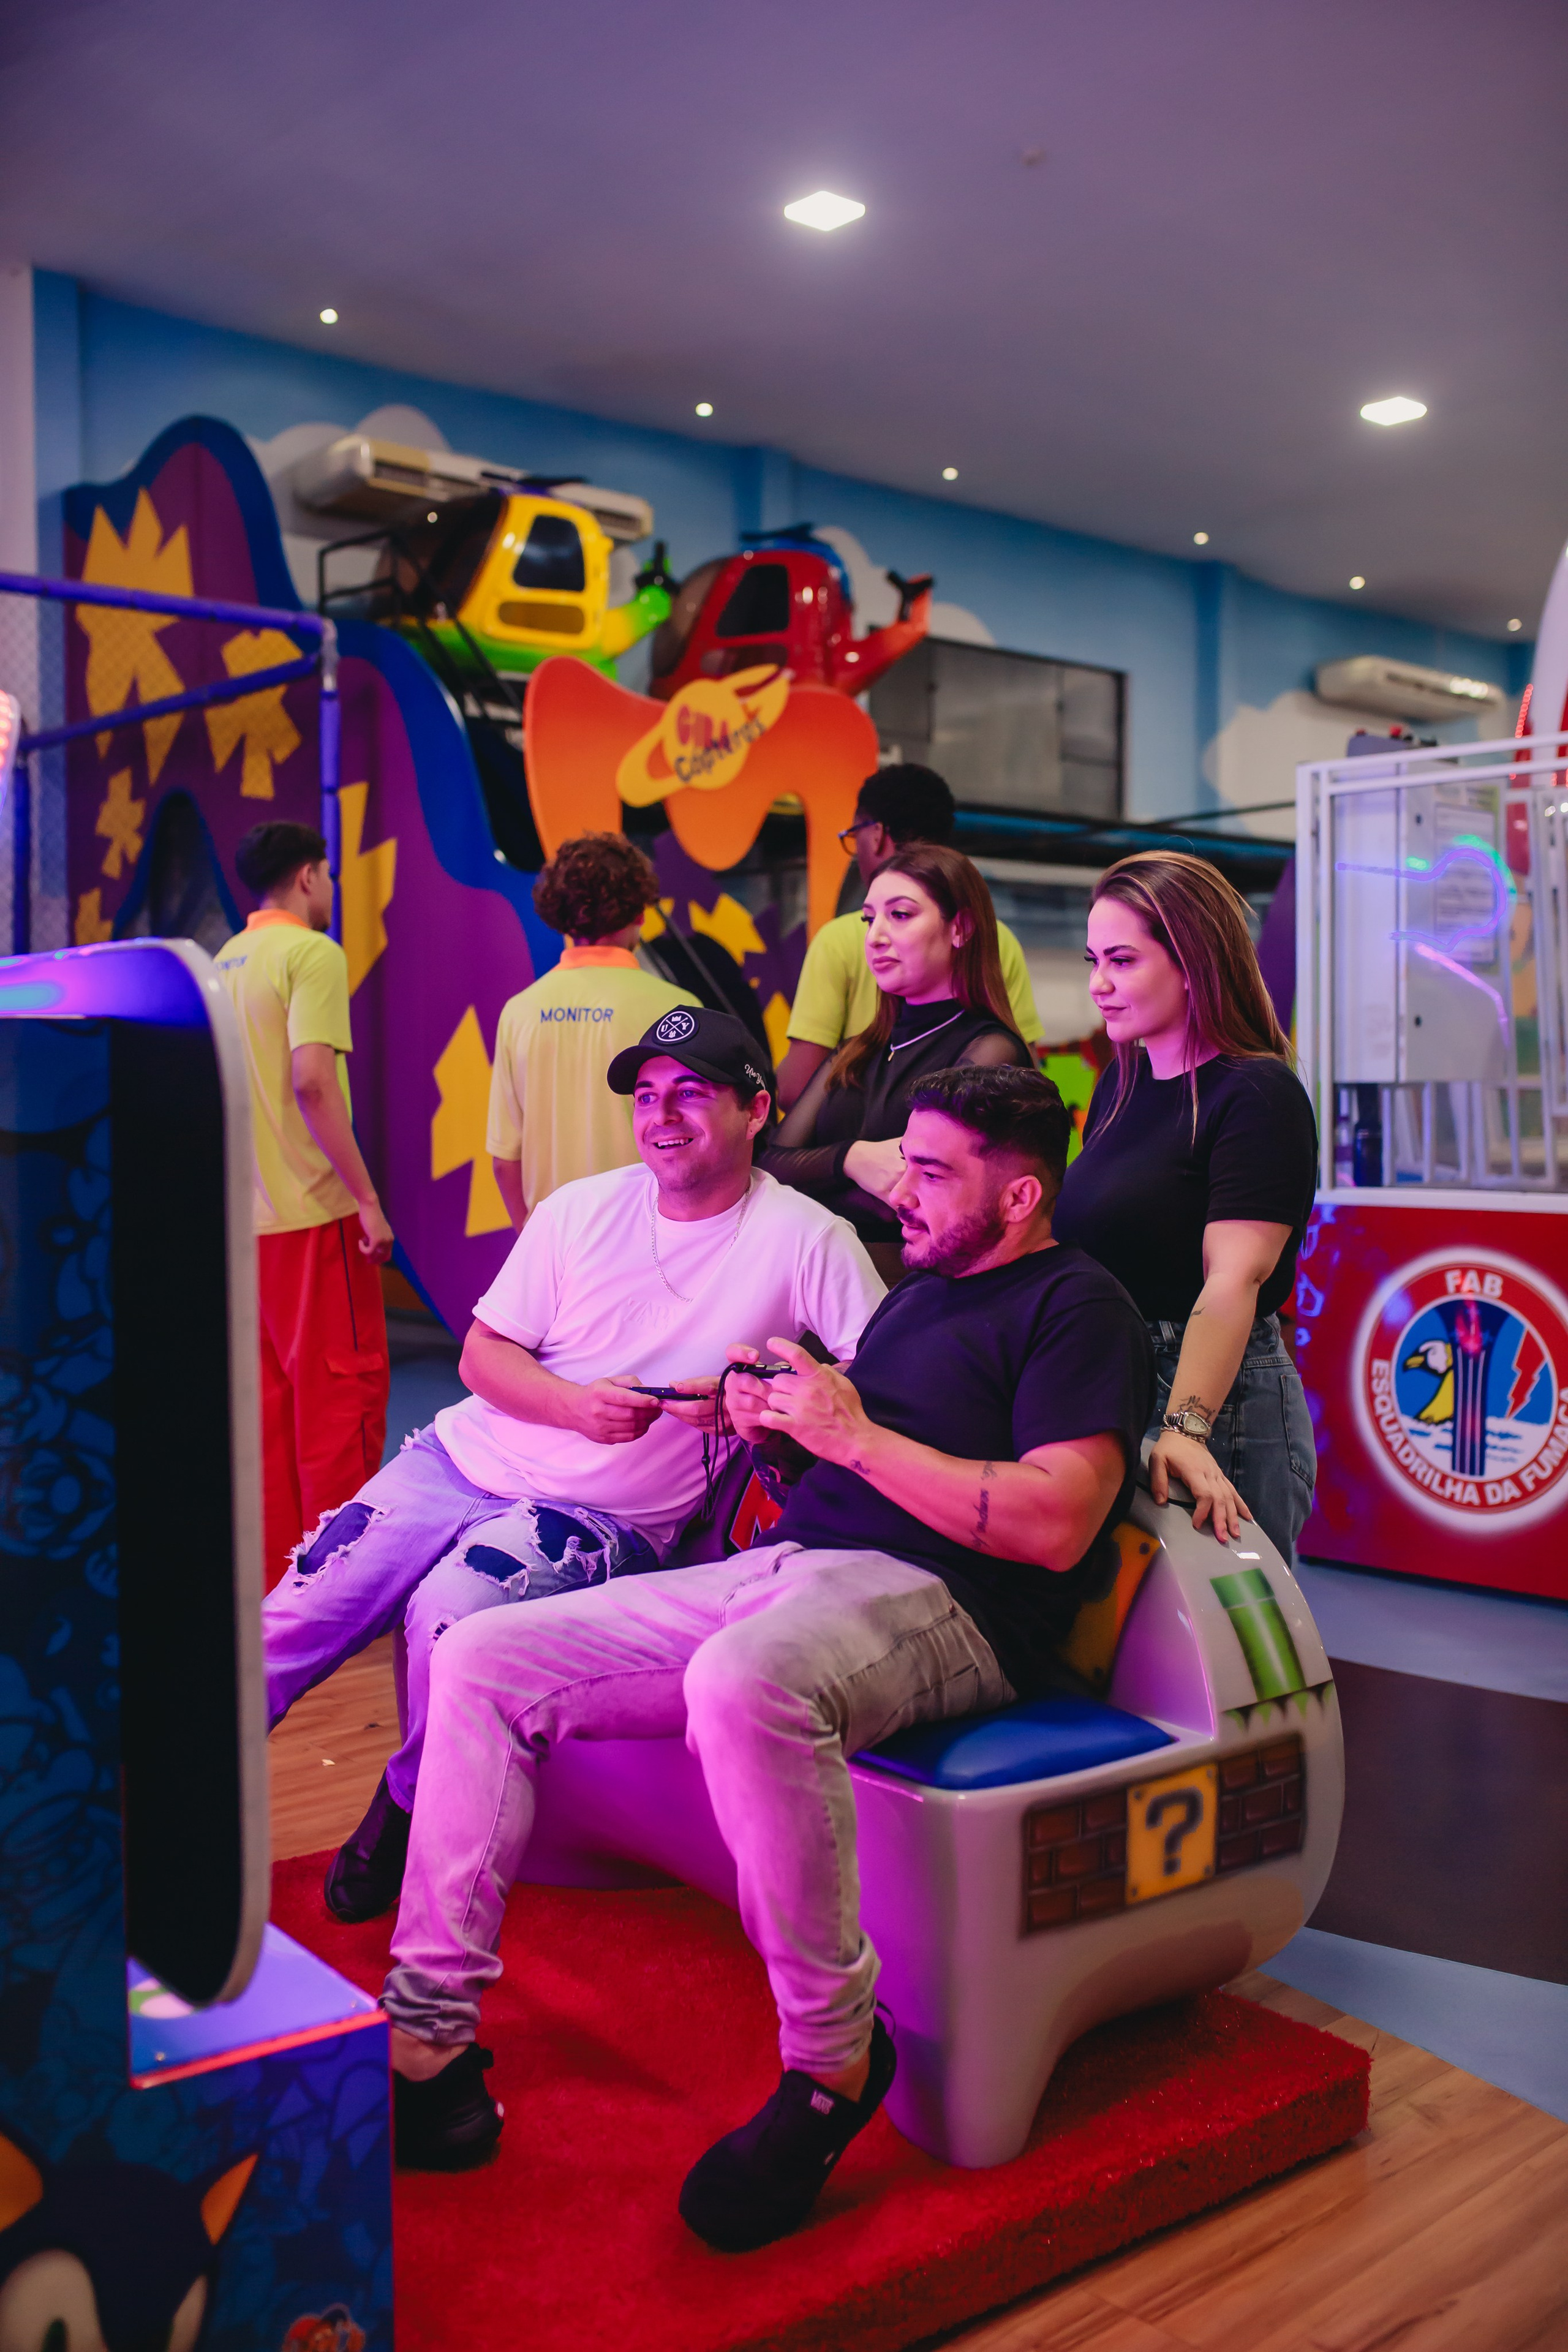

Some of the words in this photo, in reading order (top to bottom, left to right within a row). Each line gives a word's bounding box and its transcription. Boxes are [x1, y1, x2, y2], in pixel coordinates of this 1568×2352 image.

[540, 1008, 614, 1023] MONITOR
[1445, 1270, 1502, 1298] FAB
[1371, 1358, 1480, 1506] ESQUADRILHA
[1483, 1479, 1521, 1505] DA
